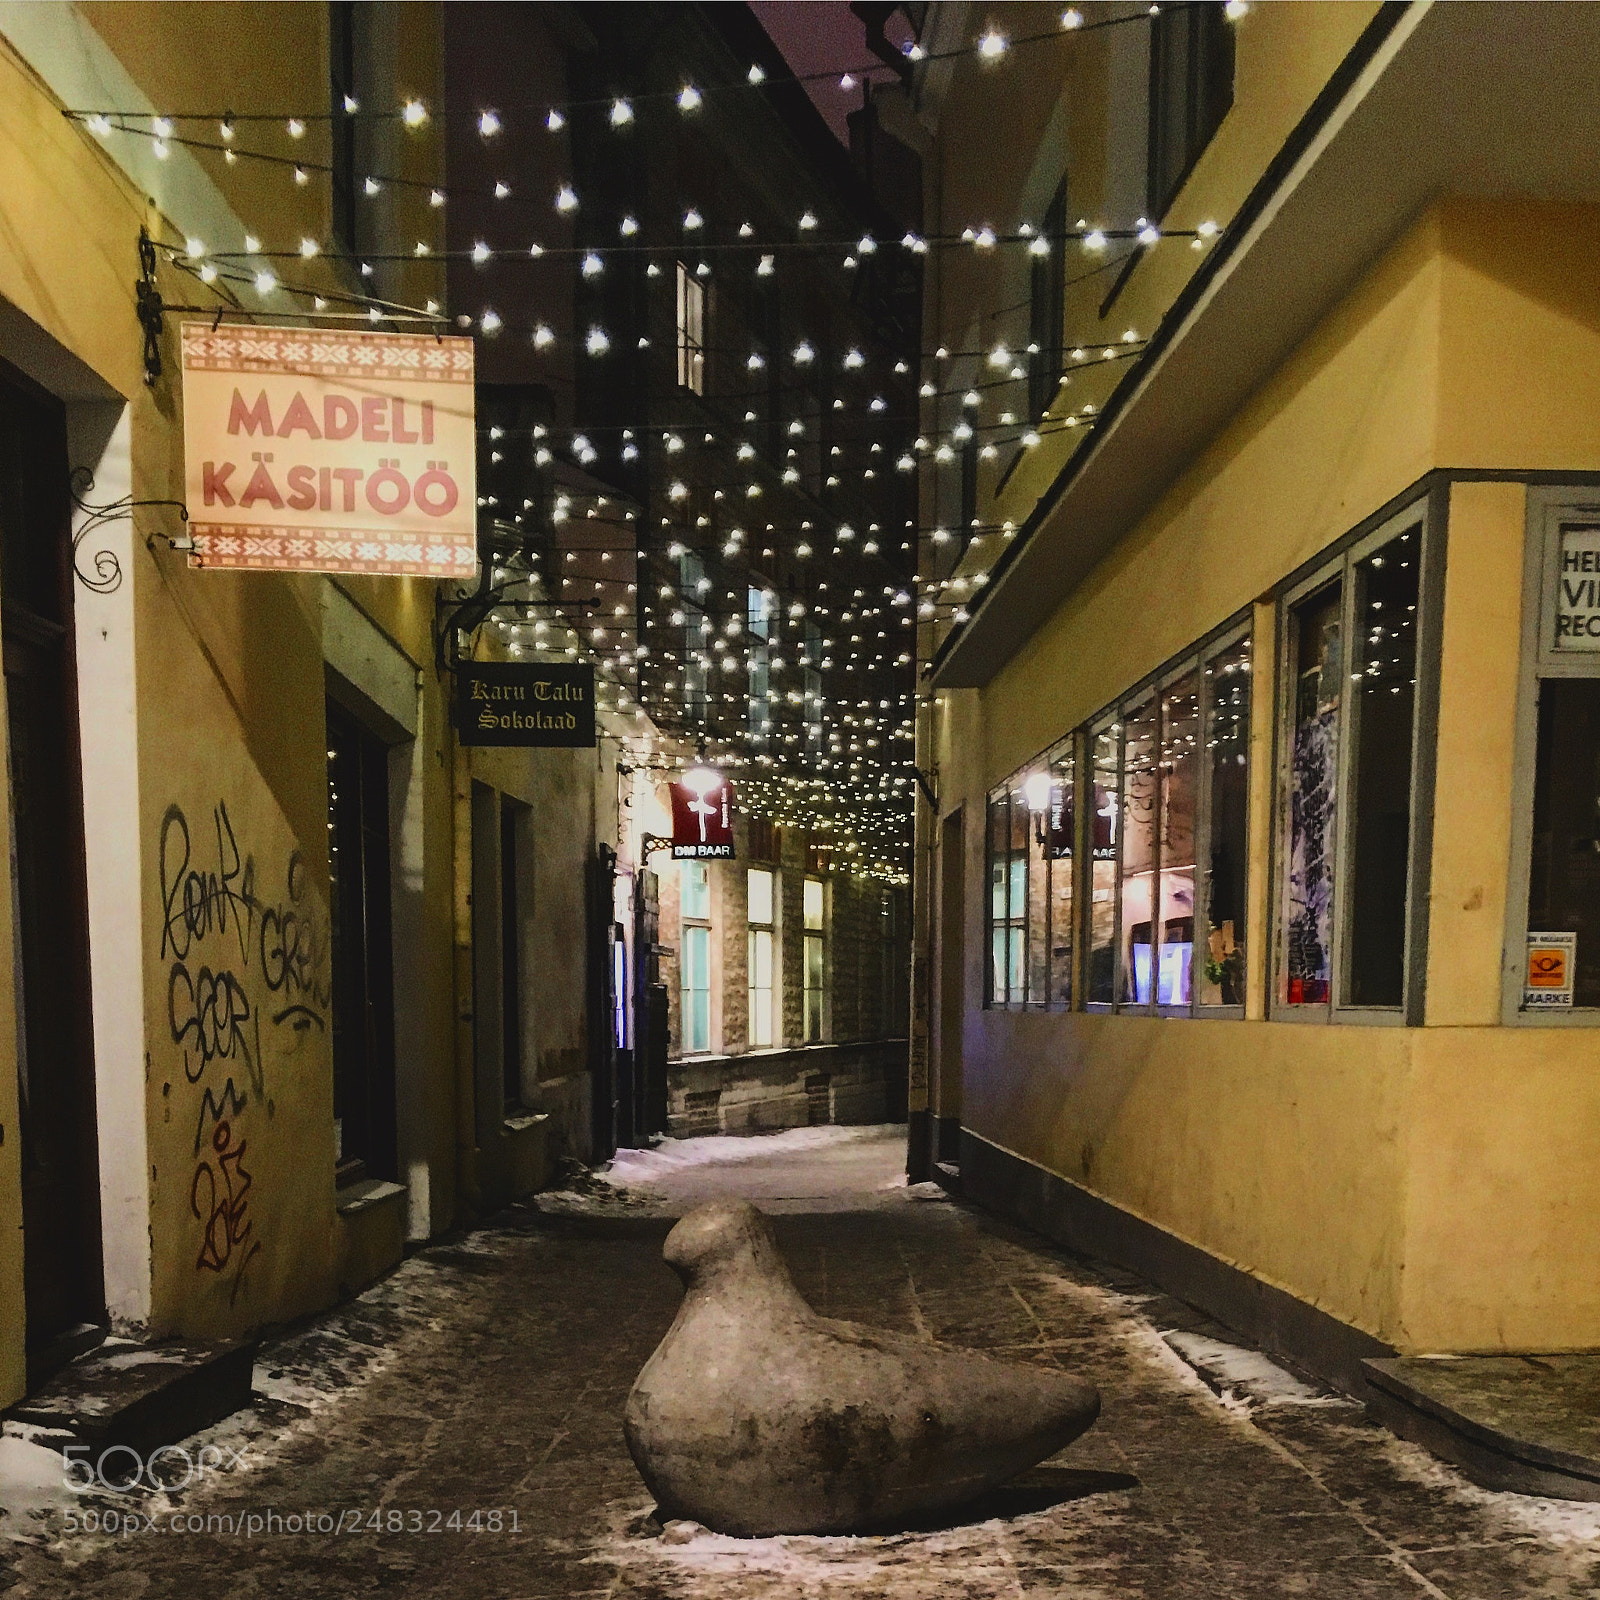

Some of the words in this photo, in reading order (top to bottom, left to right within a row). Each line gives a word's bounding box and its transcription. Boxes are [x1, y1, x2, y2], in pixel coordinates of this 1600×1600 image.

[227, 387, 433, 445] MADELI
[202, 452, 459, 517] KÄSITÖÖ
[470, 680, 525, 701] Karu
[533, 681, 584, 701] Talu
[478, 703, 576, 730] Šokolaad
[697, 845, 731, 857] BAAR
